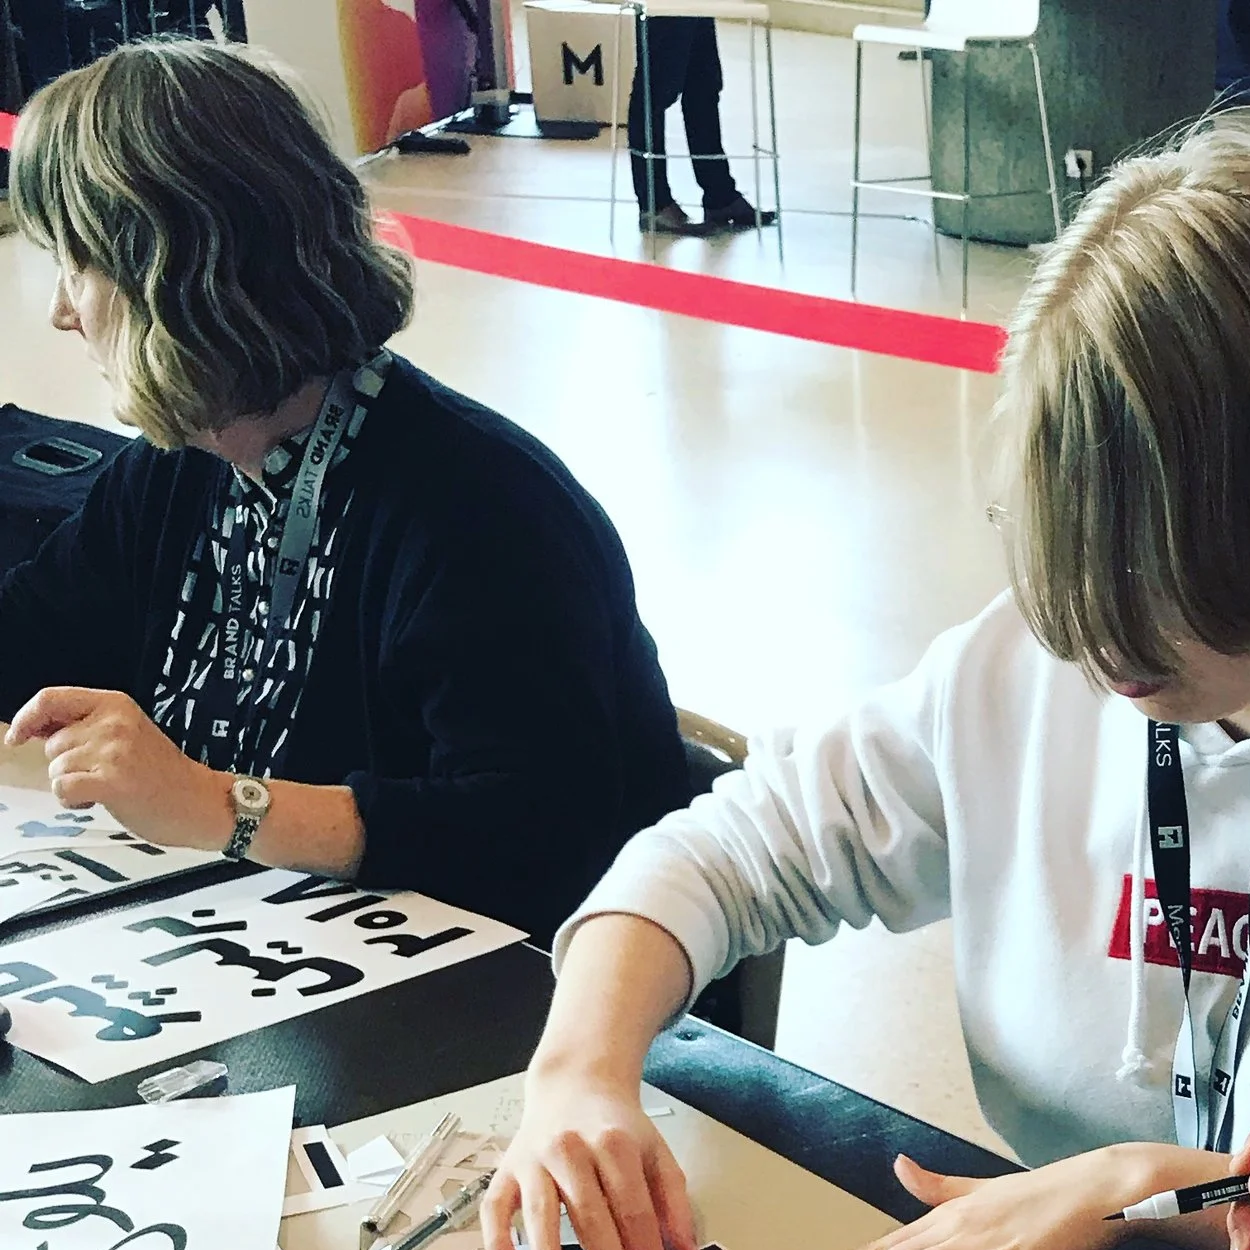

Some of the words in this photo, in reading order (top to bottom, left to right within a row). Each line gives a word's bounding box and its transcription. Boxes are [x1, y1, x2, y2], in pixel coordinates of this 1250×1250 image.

[562, 42, 604, 86] M
[228, 564, 242, 616] TALKS
[223, 619, 240, 680] BRAND
[1154, 721, 1172, 767] LKS
